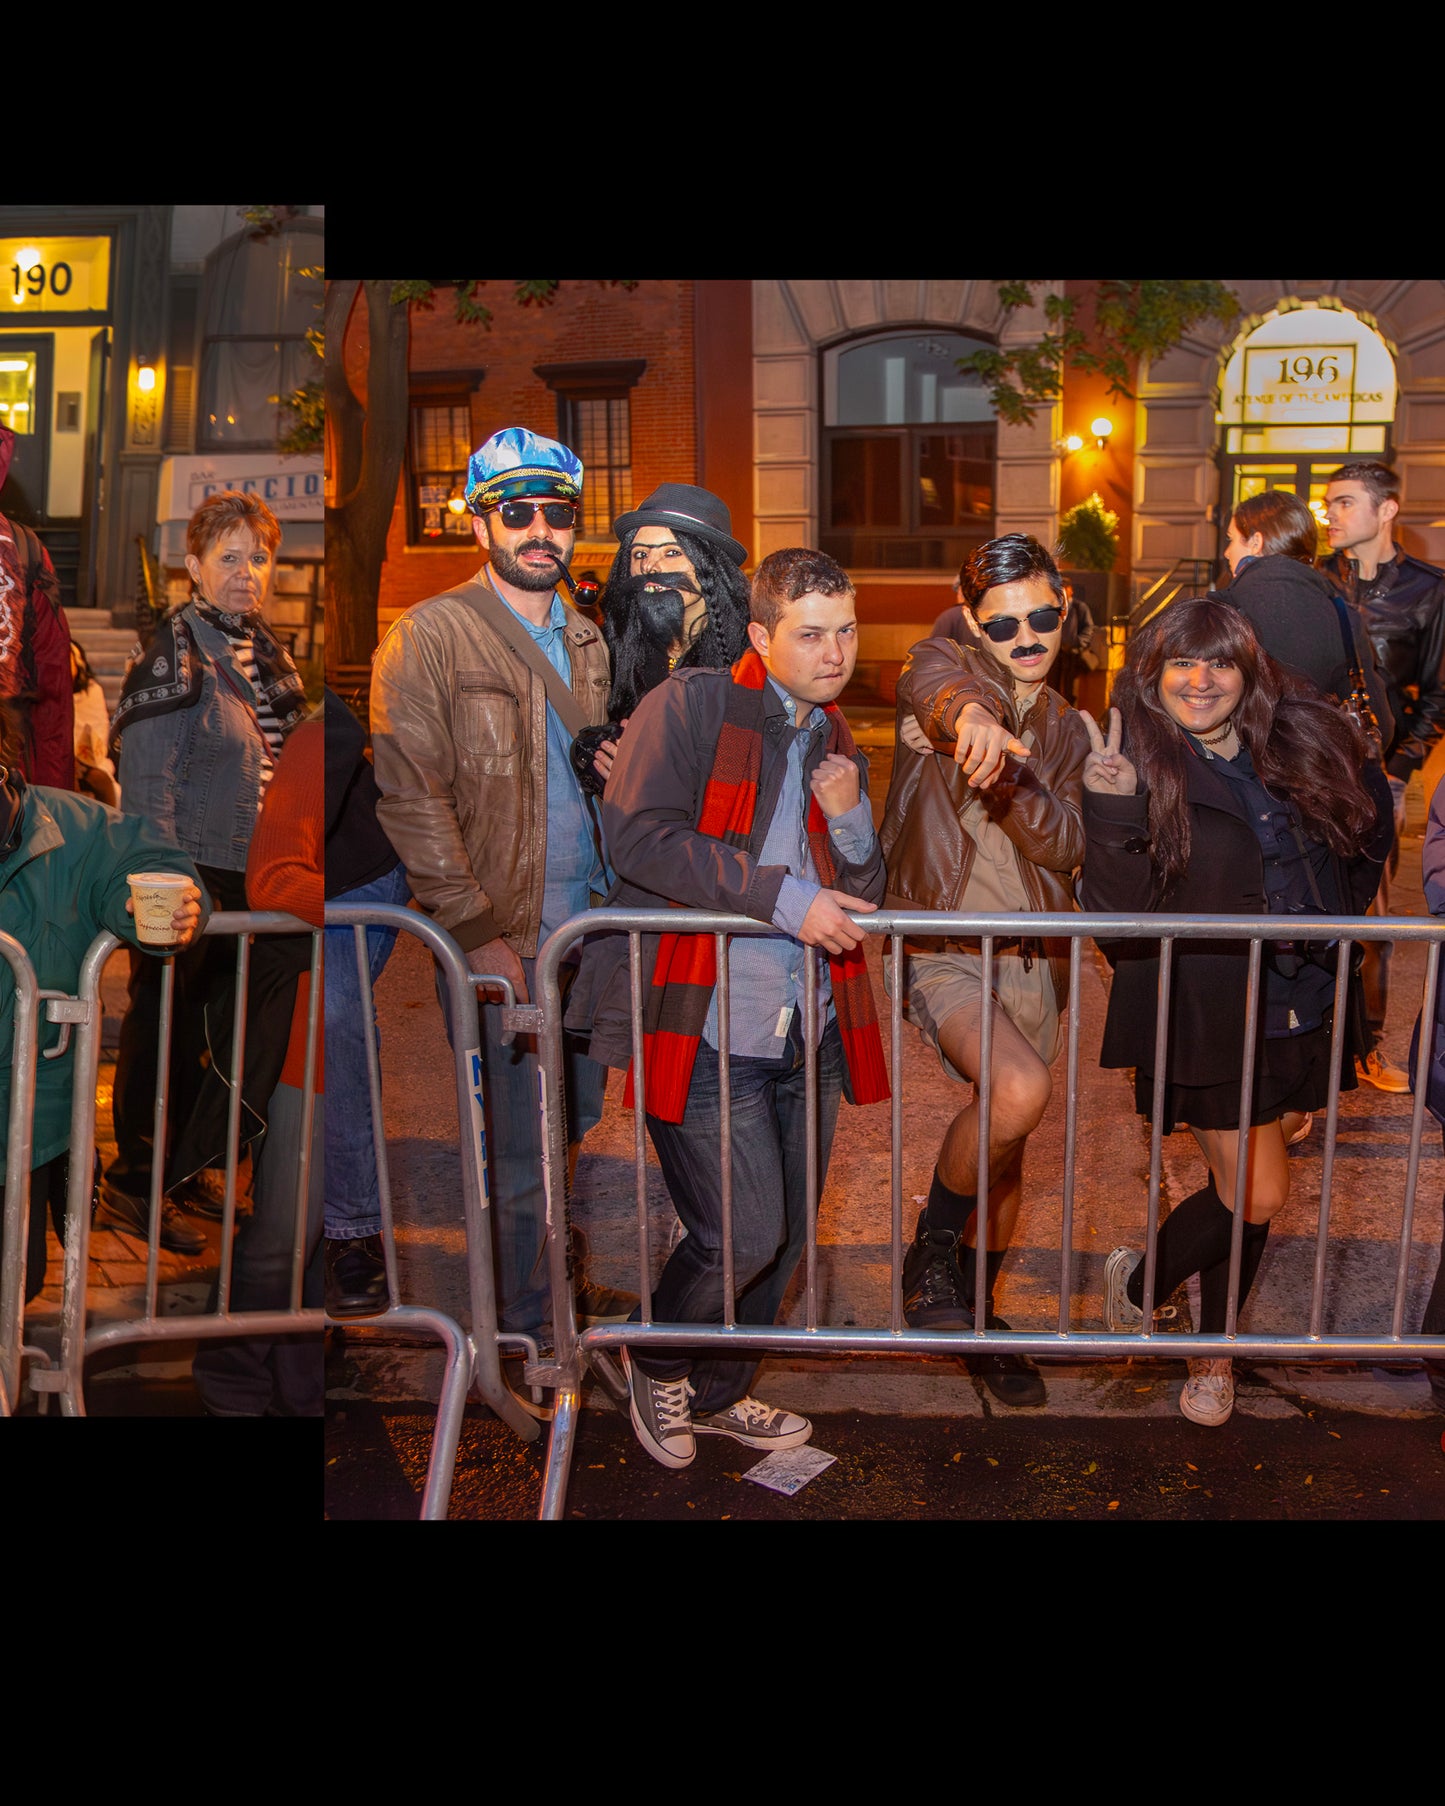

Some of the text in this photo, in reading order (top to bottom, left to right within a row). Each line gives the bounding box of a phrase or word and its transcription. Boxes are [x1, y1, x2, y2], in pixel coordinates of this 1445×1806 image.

[11, 262, 73, 296] 190
[1278, 355, 1339, 384] 196
[1279, 393, 1293, 404] OF
